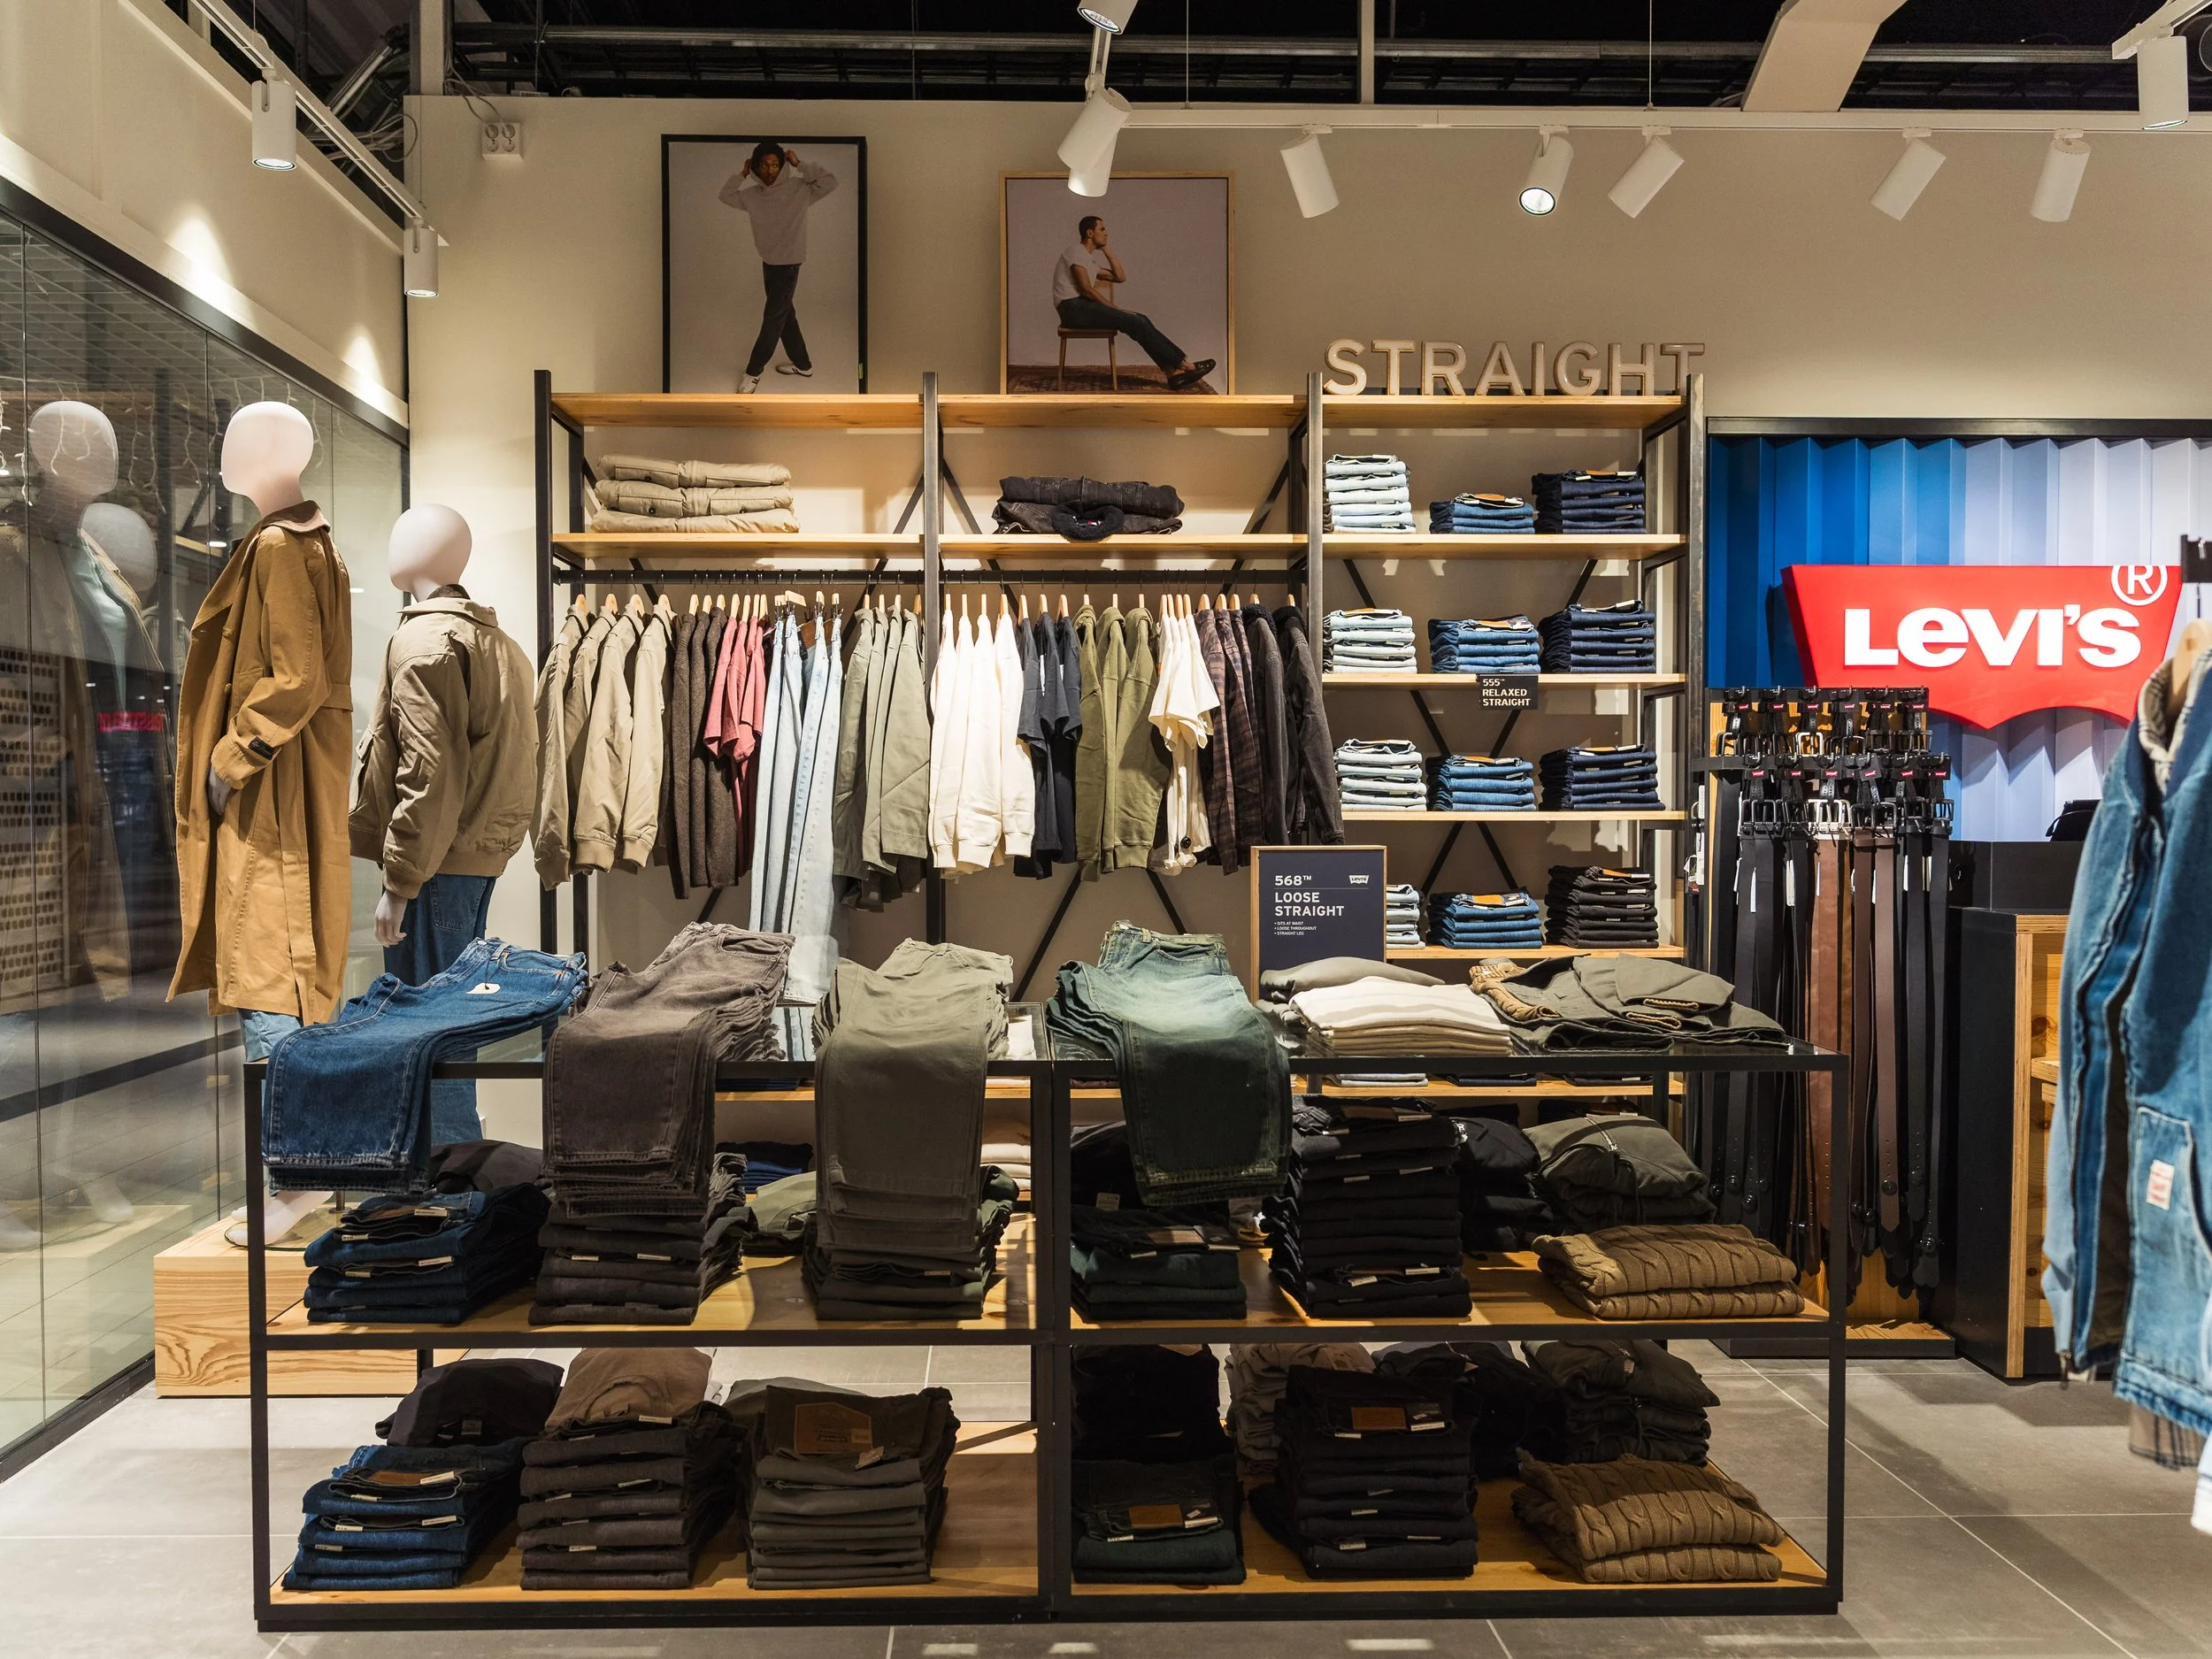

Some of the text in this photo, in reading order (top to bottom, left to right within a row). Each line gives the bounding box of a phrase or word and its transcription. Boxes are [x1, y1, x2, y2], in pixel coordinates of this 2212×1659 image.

[1324, 338, 1706, 396] STRAIGHT
[1274, 892, 1320, 903] LOOSE
[1274, 905, 1345, 917] STRAIGHT
